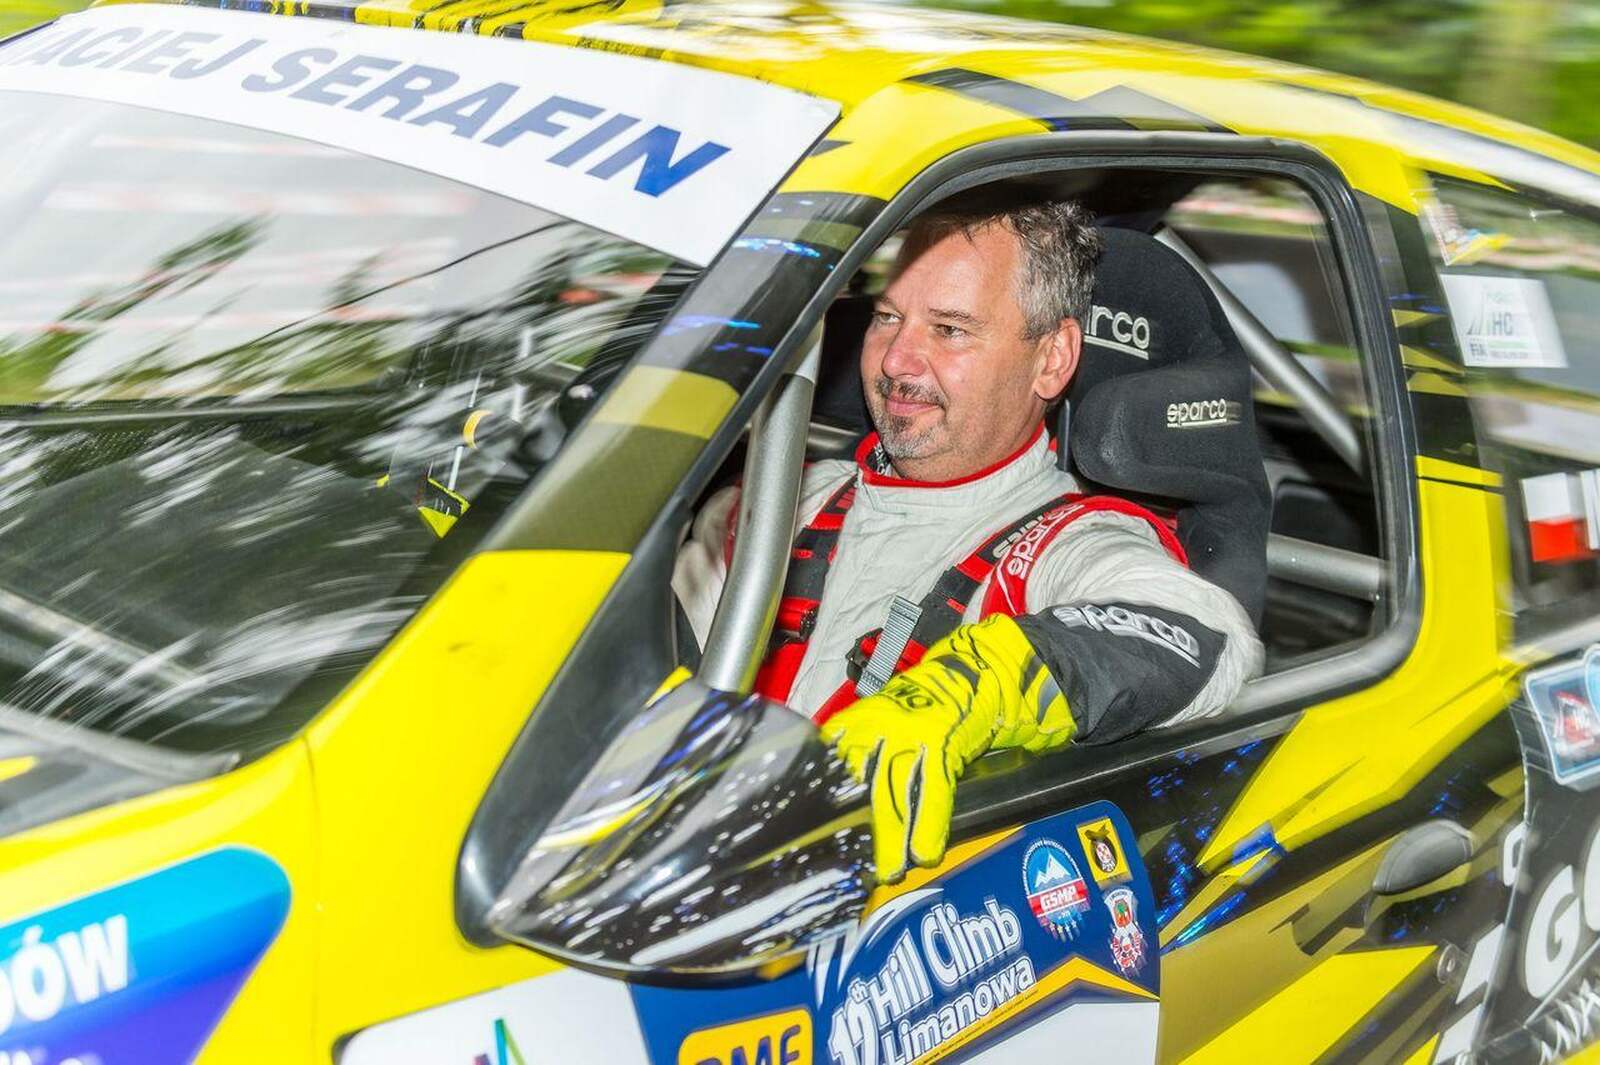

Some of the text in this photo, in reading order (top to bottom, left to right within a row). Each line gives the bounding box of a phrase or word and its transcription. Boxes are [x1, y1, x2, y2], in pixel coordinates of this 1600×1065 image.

[8, 27, 731, 198] ACIEJ SERAFIN
[1085, 304, 1150, 350] rco
[1167, 399, 1227, 427] sparco
[1053, 604, 1200, 659] sparco
[866, 928, 934, 1030] Hill
[920, 897, 1023, 987] Climb
[881, 955, 1037, 1065] Limanowa
